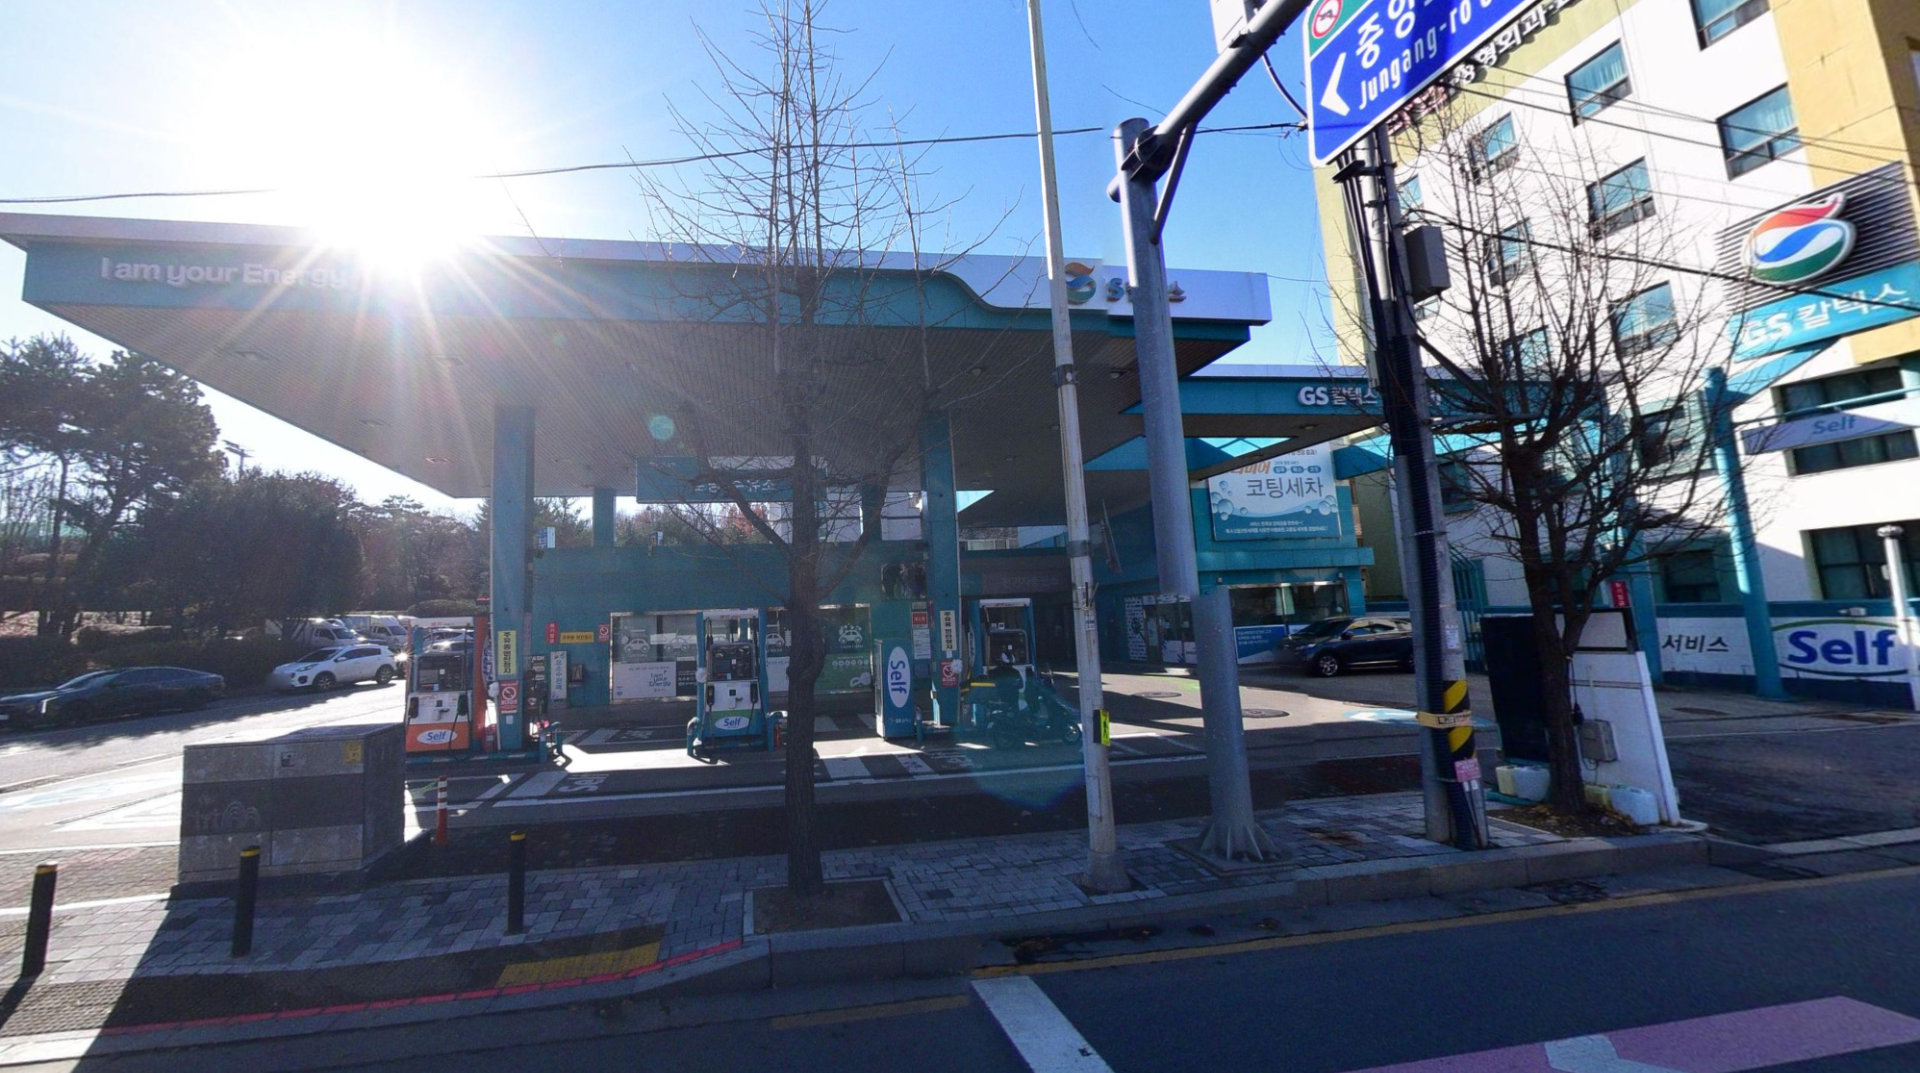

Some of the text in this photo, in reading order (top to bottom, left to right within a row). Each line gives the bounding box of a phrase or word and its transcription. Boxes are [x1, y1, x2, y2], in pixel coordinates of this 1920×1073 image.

[1356, 0, 1434, 69] 중앙
[1359, 0, 1472, 110] Jungang-ro
[101, 257, 346, 289] I am your Energy
[1742, 283, 1911, 346] GS 칼텍스
[1298, 386, 1380, 406] GS 칼텍스
[1813, 414, 1857, 435] Self
[1246, 477, 1324, 499] 코팅세차
[1662, 634, 1729, 654] 서비스
[1787, 630, 1897, 666] Self
[890, 660, 907, 694] Self
[426, 731, 446, 741] Self
[723, 717, 741, 728] Self
